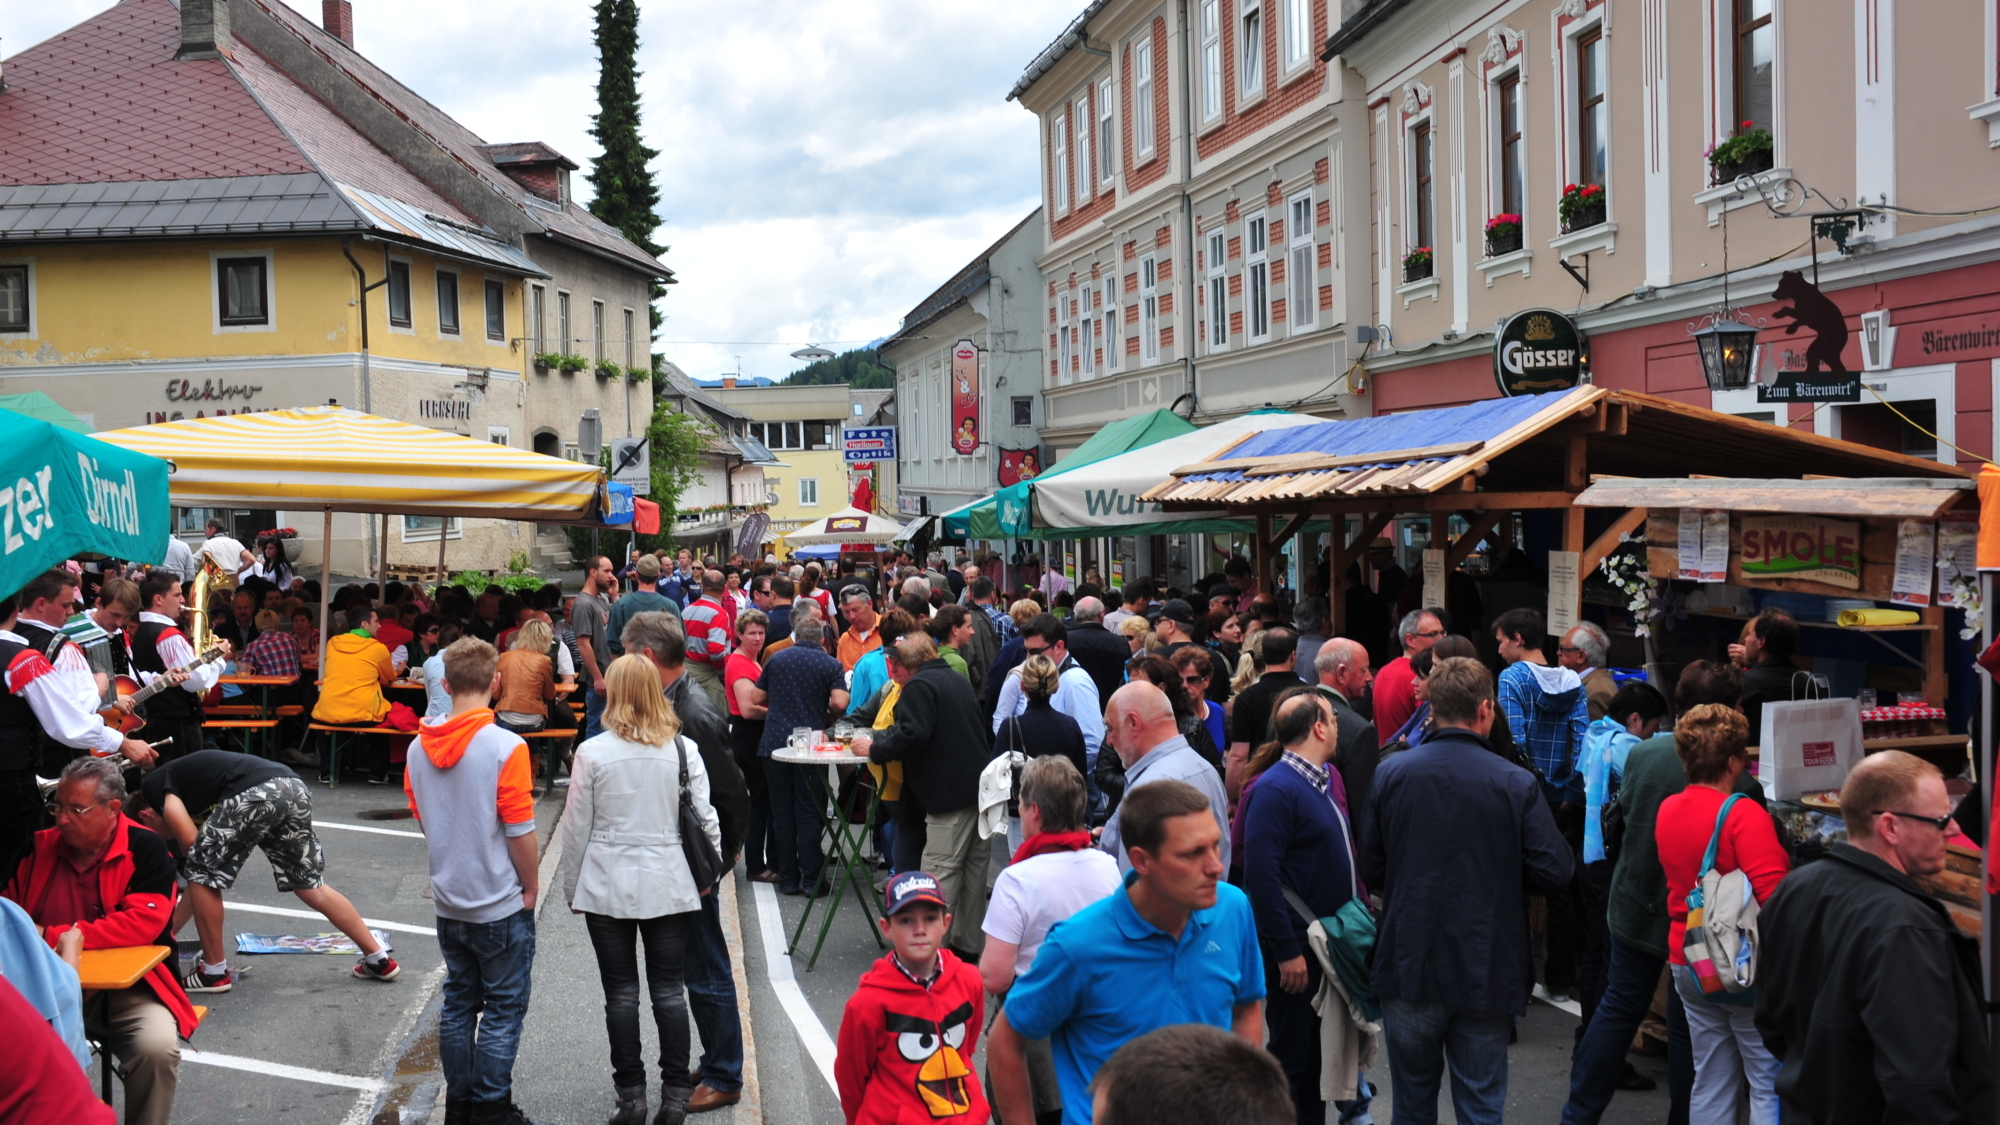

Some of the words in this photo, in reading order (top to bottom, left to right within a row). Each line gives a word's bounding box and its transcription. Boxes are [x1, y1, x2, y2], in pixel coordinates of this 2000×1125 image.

[1866, 322, 1878, 342] 17
[1502, 341, 1575, 375] Gösser
[166, 378, 262, 401] Elektro
[848, 430, 889, 439] Foto
[850, 440, 881, 449] Hartlauer
[849, 450, 891, 459] Optik
[77, 452, 140, 536] Dirndl
[803, 539, 831, 547] ORIGINAL
[1743, 525, 1855, 568] SMOLE
